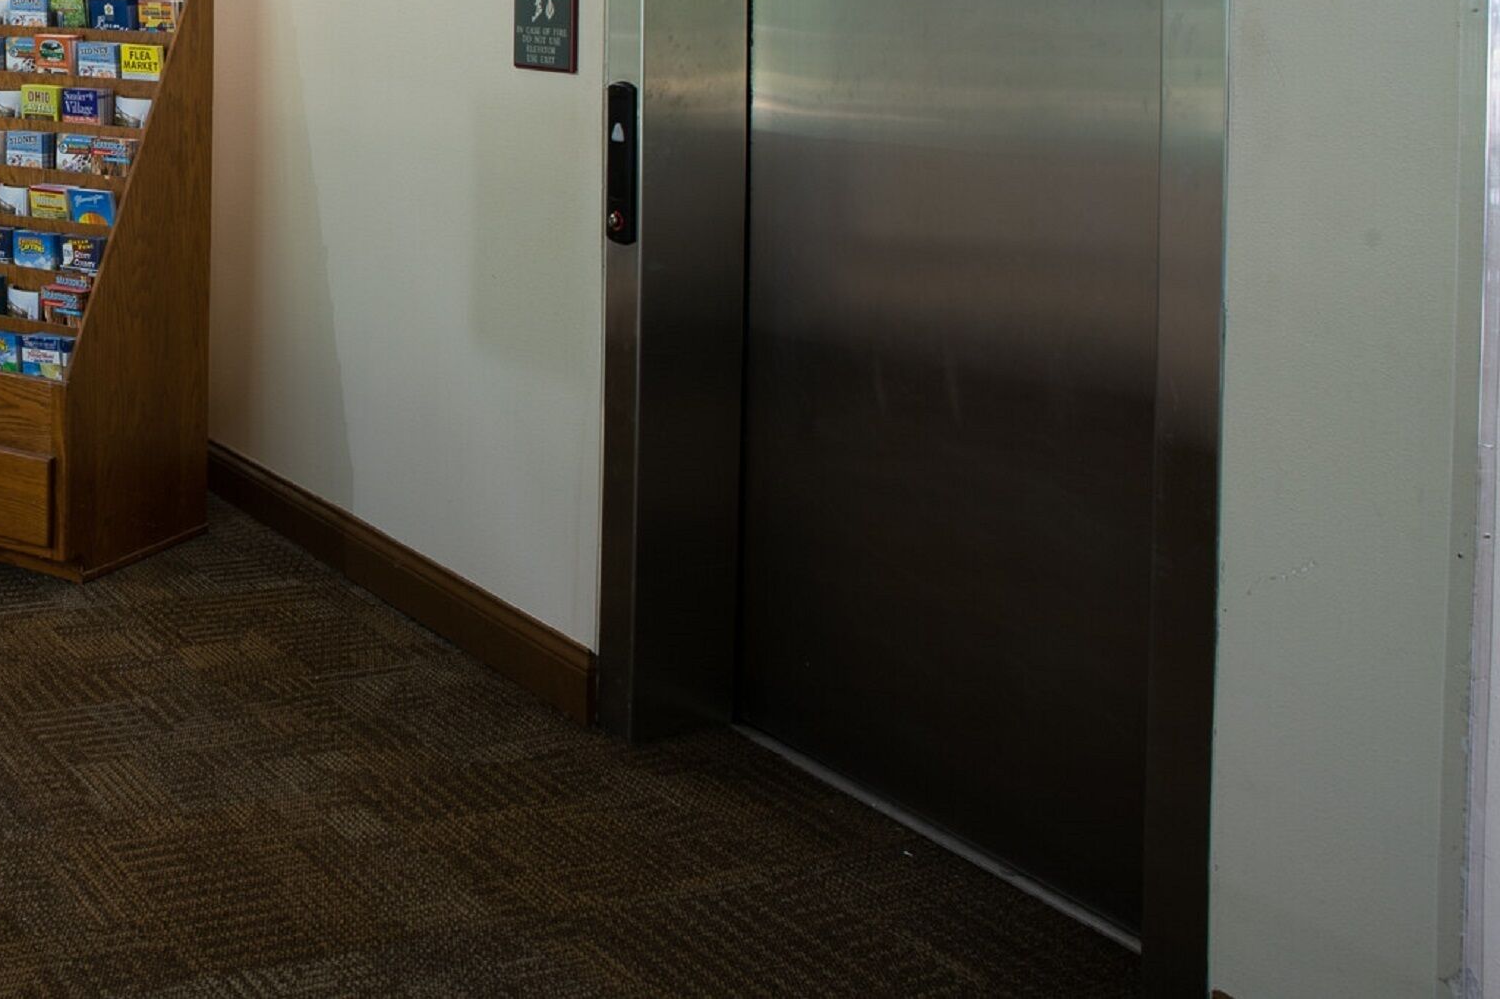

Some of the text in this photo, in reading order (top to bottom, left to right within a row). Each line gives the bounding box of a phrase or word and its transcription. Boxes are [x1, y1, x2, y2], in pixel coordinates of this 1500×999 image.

[525, 26, 540, 35] CASE
[542, 27, 551, 36] OF
[553, 28, 567, 37] FIRE
[522, 34, 532, 43] DO
[534, 35, 546, 44] NOT
[129, 51, 151, 61] FLEA
[123, 61, 158, 72] MARKET
[28, 91, 50, 103] OHIO
